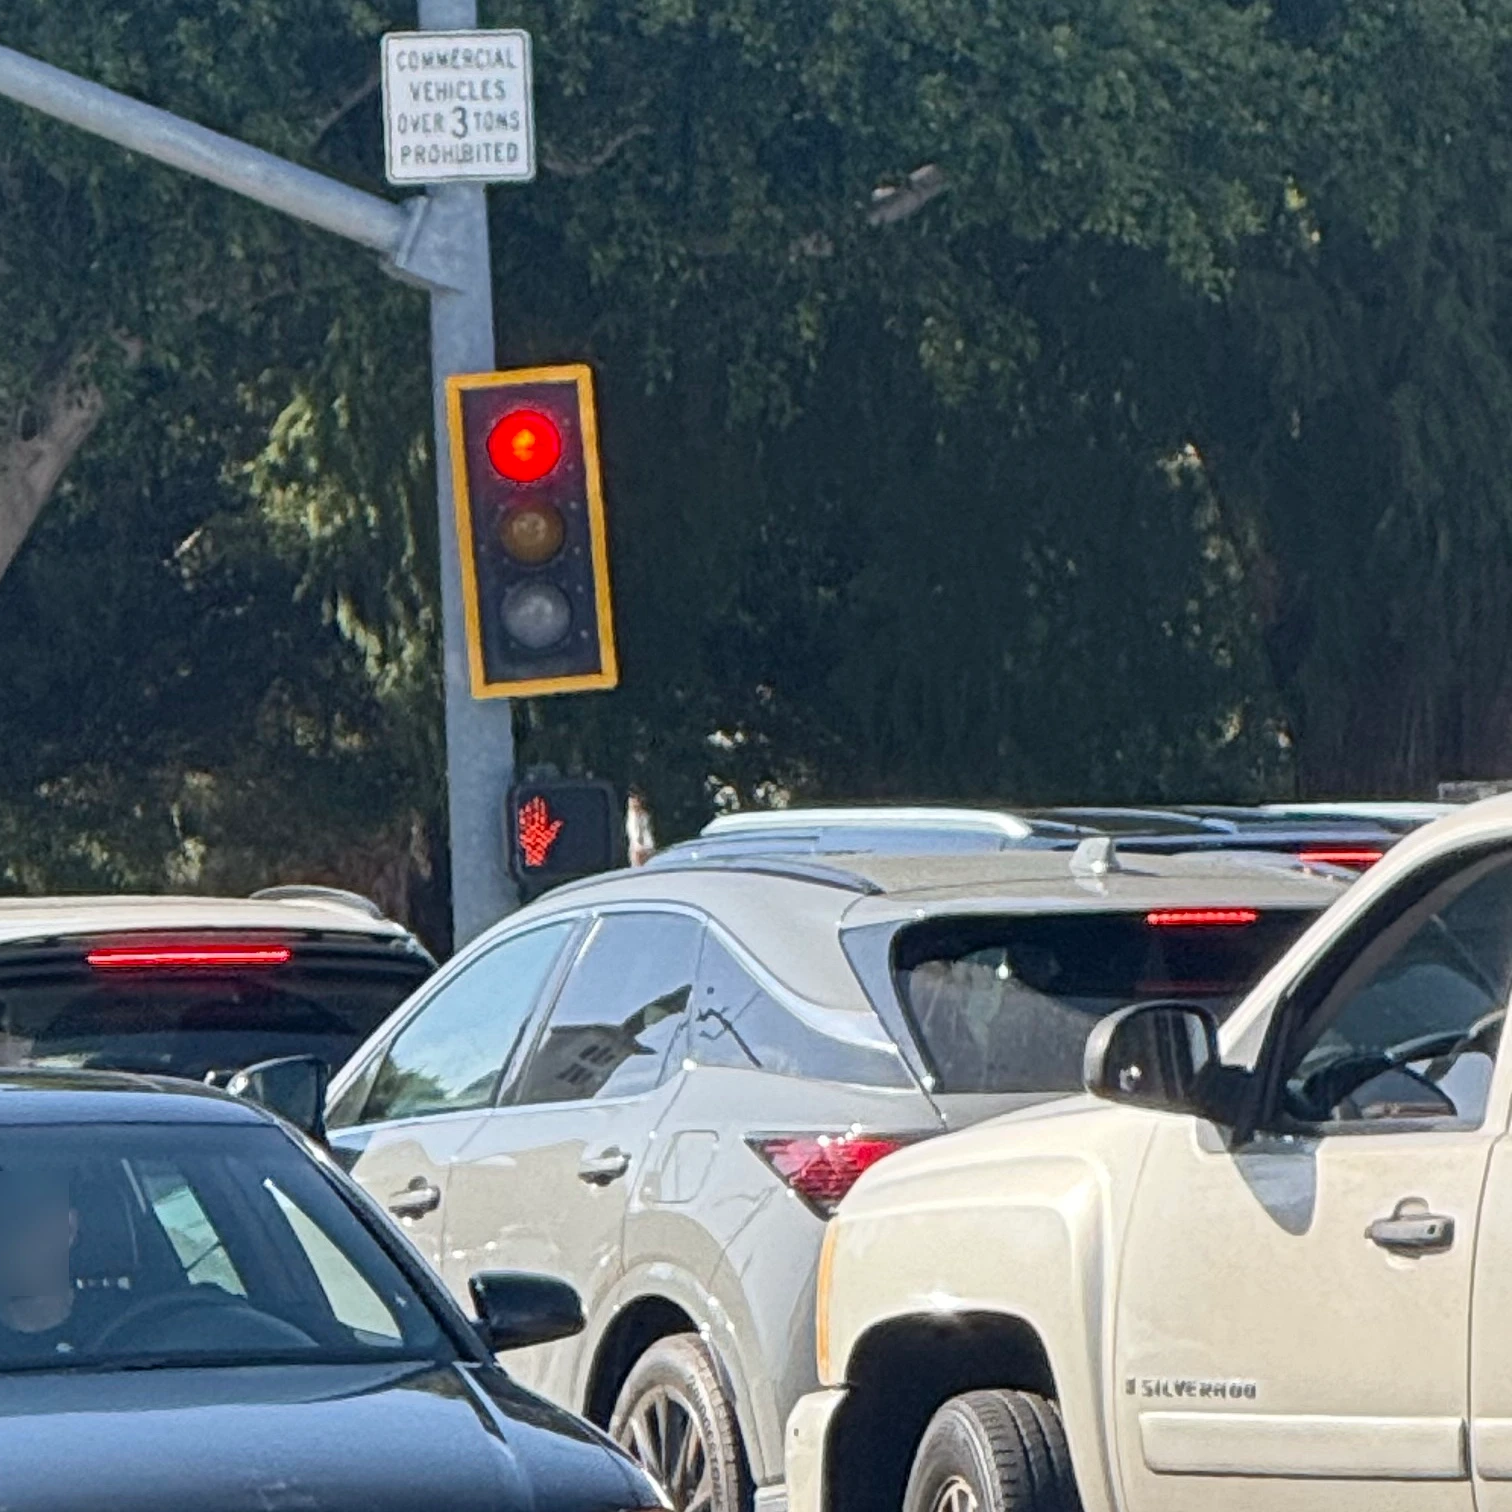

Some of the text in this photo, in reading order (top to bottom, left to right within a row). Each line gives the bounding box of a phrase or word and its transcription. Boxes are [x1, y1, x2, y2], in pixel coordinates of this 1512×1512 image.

[396, 47, 518, 71] COMMERCIAL
[410, 79, 506, 101] VEHICLES
[397, 106, 520, 139] OVER 3 TONS
[400, 143, 518, 165] PROHIBITED
